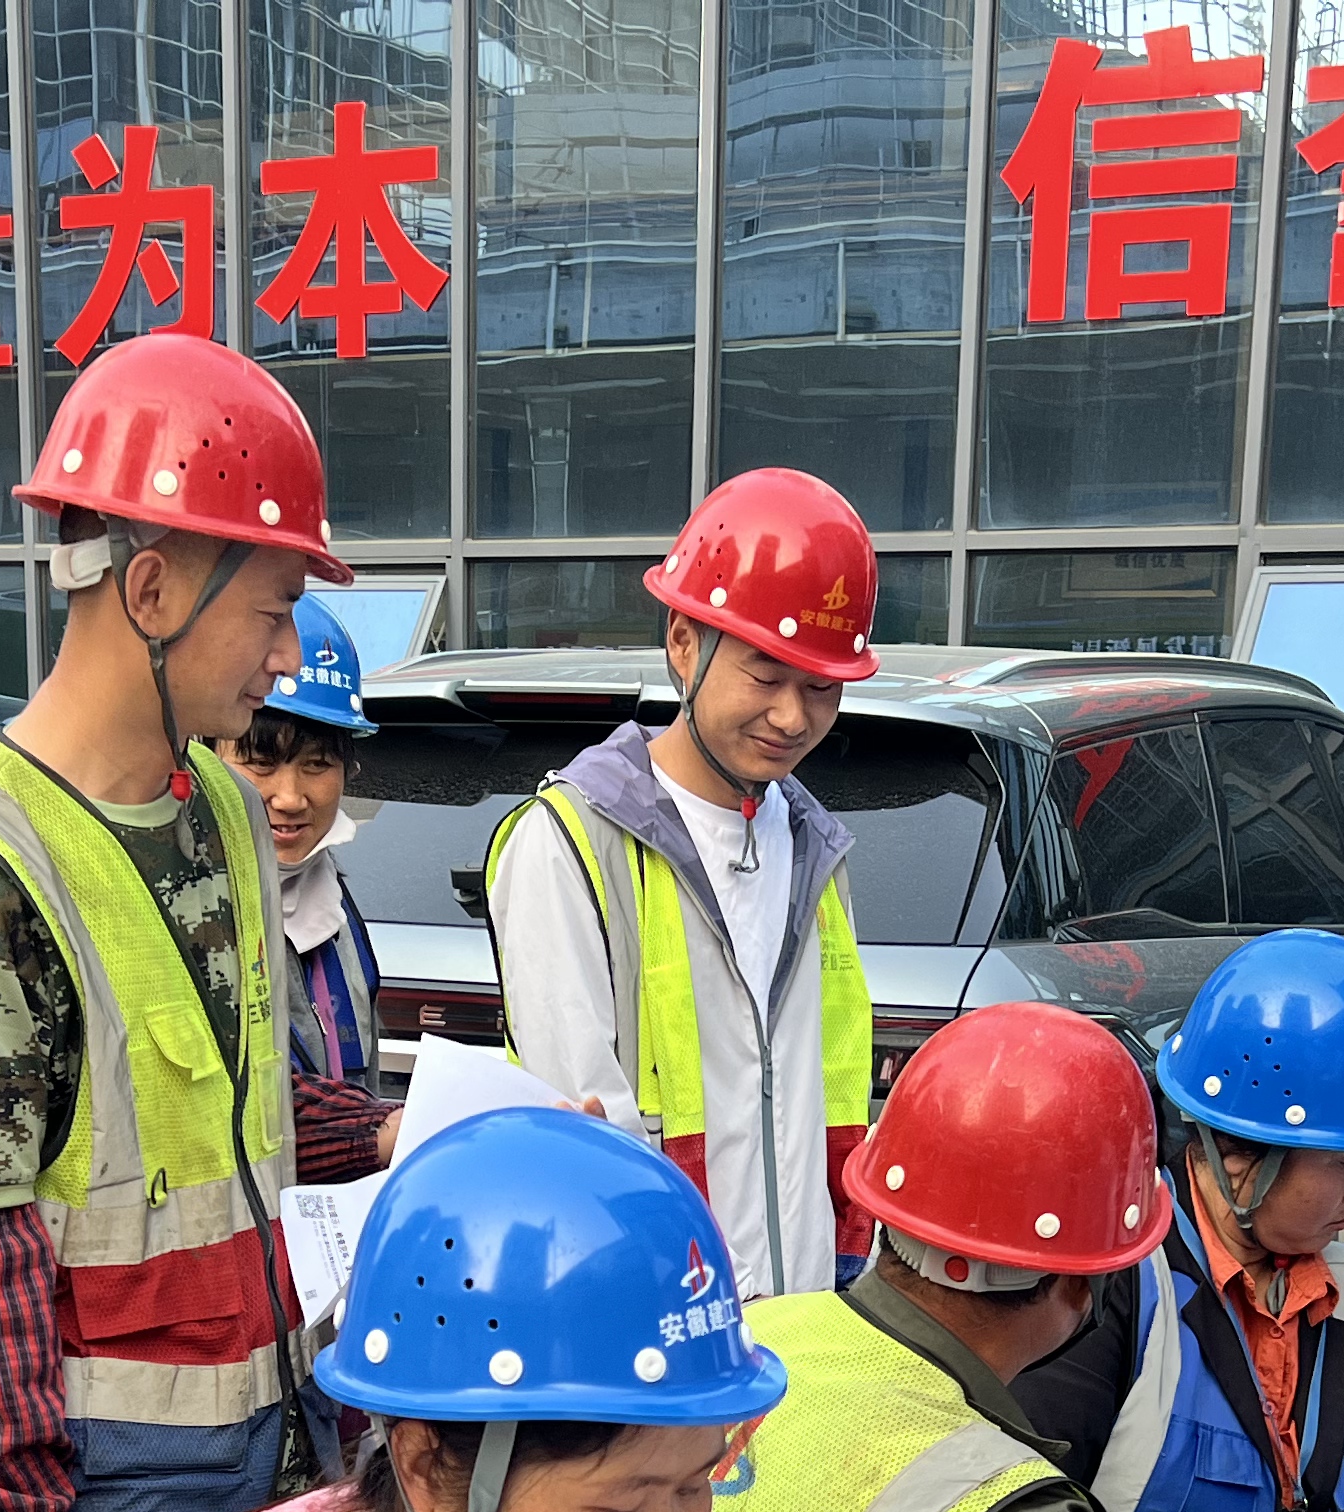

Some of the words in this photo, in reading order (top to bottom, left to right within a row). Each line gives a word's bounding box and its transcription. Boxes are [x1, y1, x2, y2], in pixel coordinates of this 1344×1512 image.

[799, 609, 855, 633] 安徽建工
[299, 665, 353, 690] 安徽建工
[658, 1298, 740, 1348] 安徽建工
